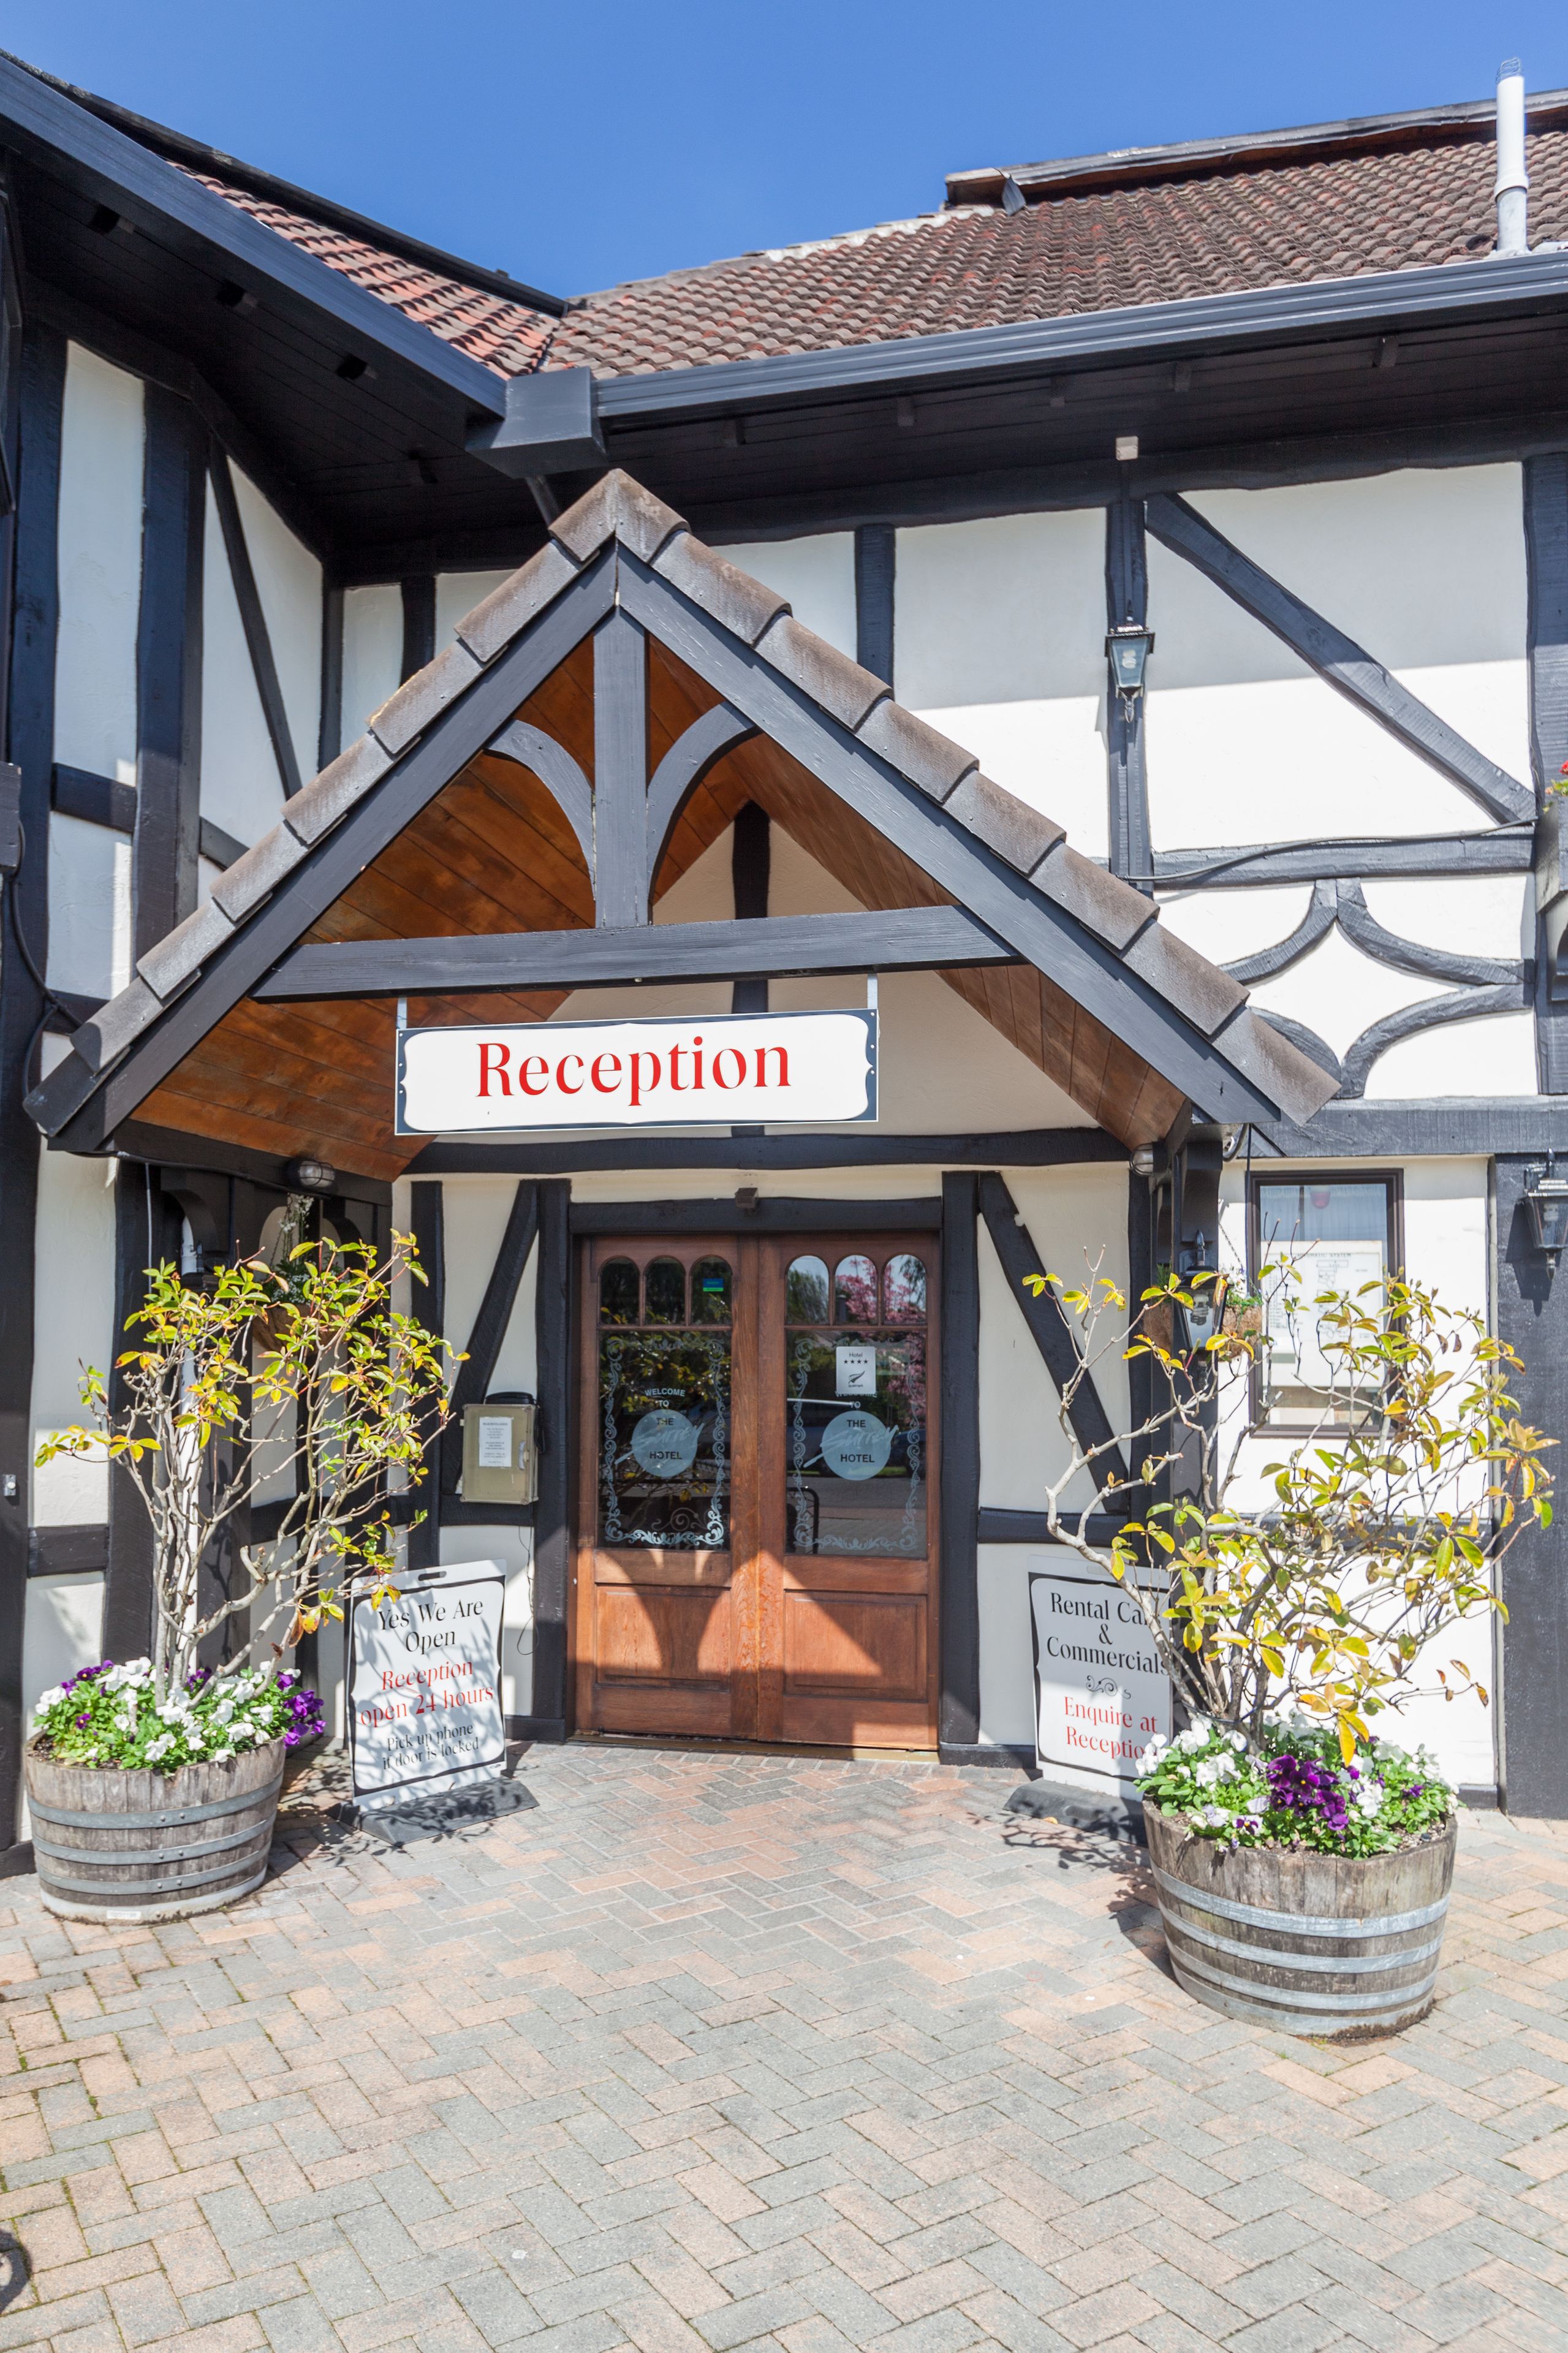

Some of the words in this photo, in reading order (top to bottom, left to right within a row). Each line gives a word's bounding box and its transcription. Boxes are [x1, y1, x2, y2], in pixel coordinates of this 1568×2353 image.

[475, 1036, 791, 1106] Reception
[645, 1388, 686, 1397] WELCOME
[656, 1417, 674, 1426] THE
[650, 1451, 683, 1460] HOTEL
[840, 1454, 875, 1463] HOTEL
[377, 1610, 410, 1631] Yes
[418, 1602, 446, 1624] We
[453, 1599, 483, 1619] Are
[1050, 1592, 1110, 1620] Rental
[406, 1631, 455, 1655] Open
[1099, 1623, 1113, 1645] &
[382, 1661, 473, 1691] Reception
[361, 1703, 407, 1728] open
[415, 1693, 436, 1715] 24
[444, 1686, 493, 1710] hours
[1064, 1696, 1132, 1728] Enquire
[1140, 1716, 1158, 1733] at
[387, 1734, 413, 1751] Pick
[417, 1733, 432, 1746] up
[437, 1724, 474, 1744] phone
[1066, 1726, 1157, 1760] Receptio
[383, 1755, 392, 1770] if
[395, 1752, 423, 1767] door
[427, 1748, 437, 1760] is
[441, 1737, 479, 1757] locked
